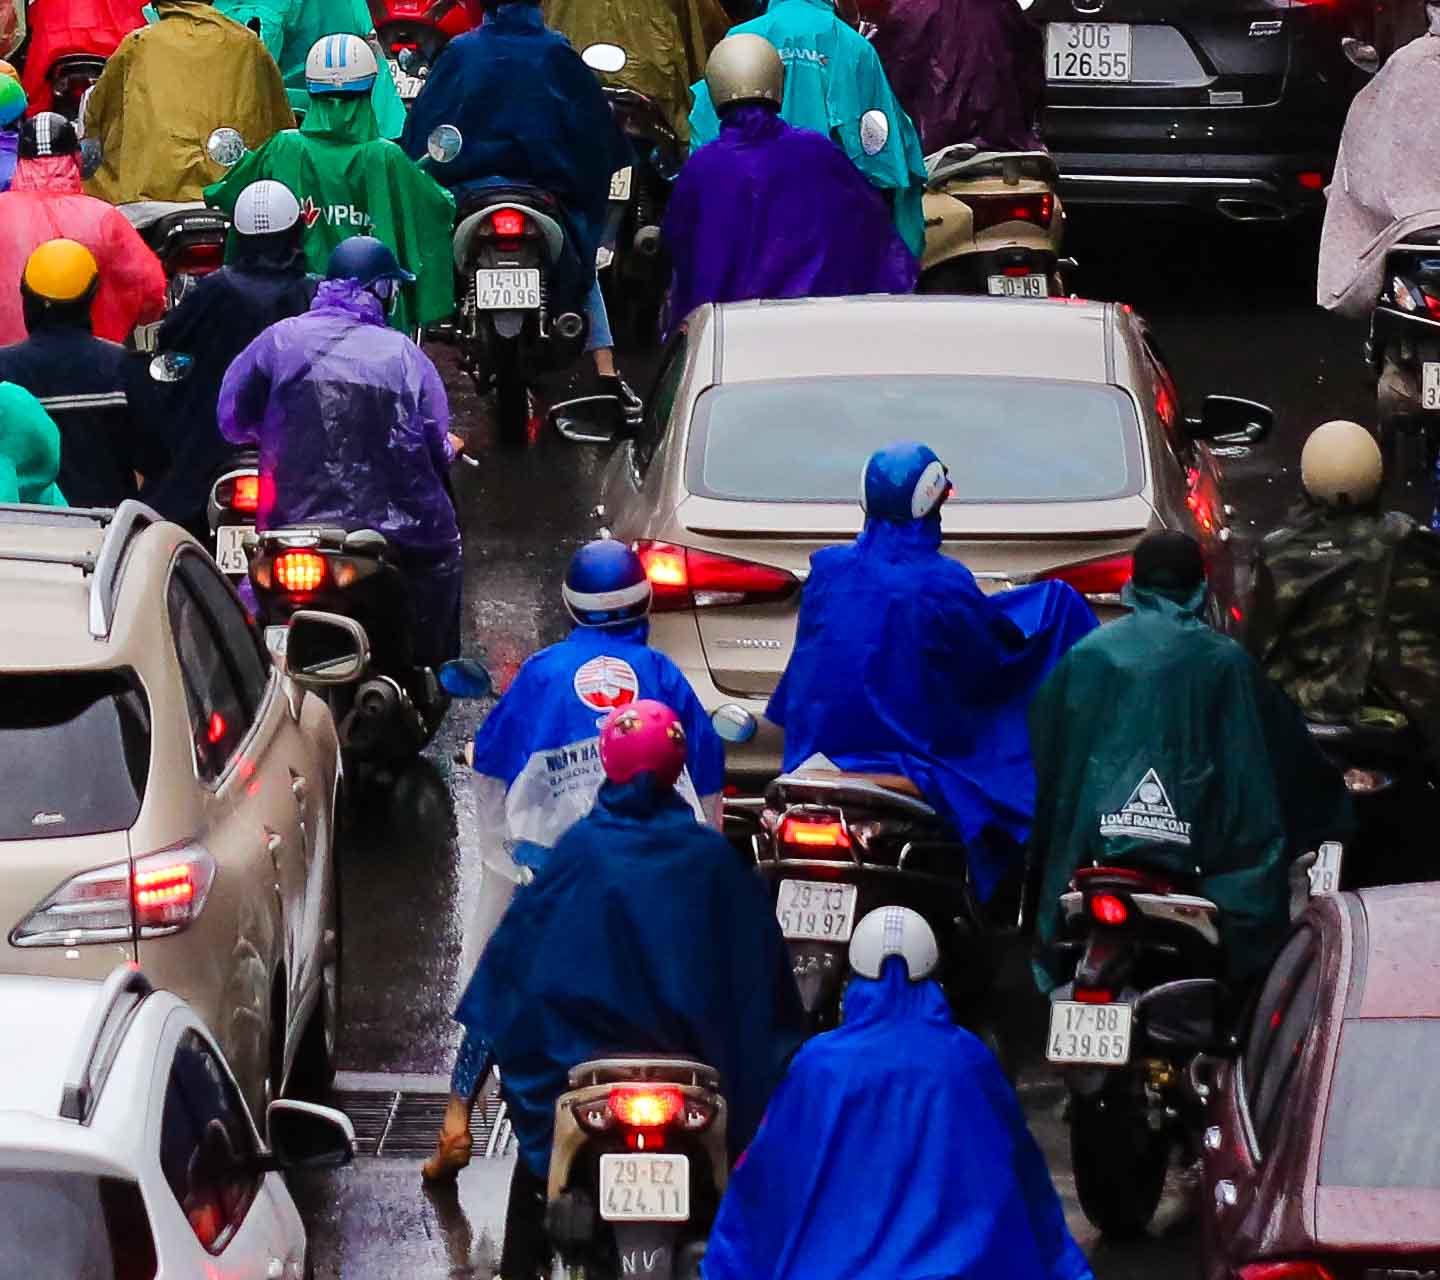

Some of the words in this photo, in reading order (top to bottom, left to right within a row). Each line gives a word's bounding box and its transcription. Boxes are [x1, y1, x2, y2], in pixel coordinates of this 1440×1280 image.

[1067, 23, 1111, 50] 30G
[1052, 52, 1127, 78] 126.55
[481, 290, 537, 305] 470.96
[1100, 813, 1133, 825] LOVE
[1133, 815, 1192, 834] RAINCOAT
[781, 910, 845, 935] 519.97
[1051, 1033, 1122, 1060] 439.65
[607, 1188, 682, 1215] 424.11
